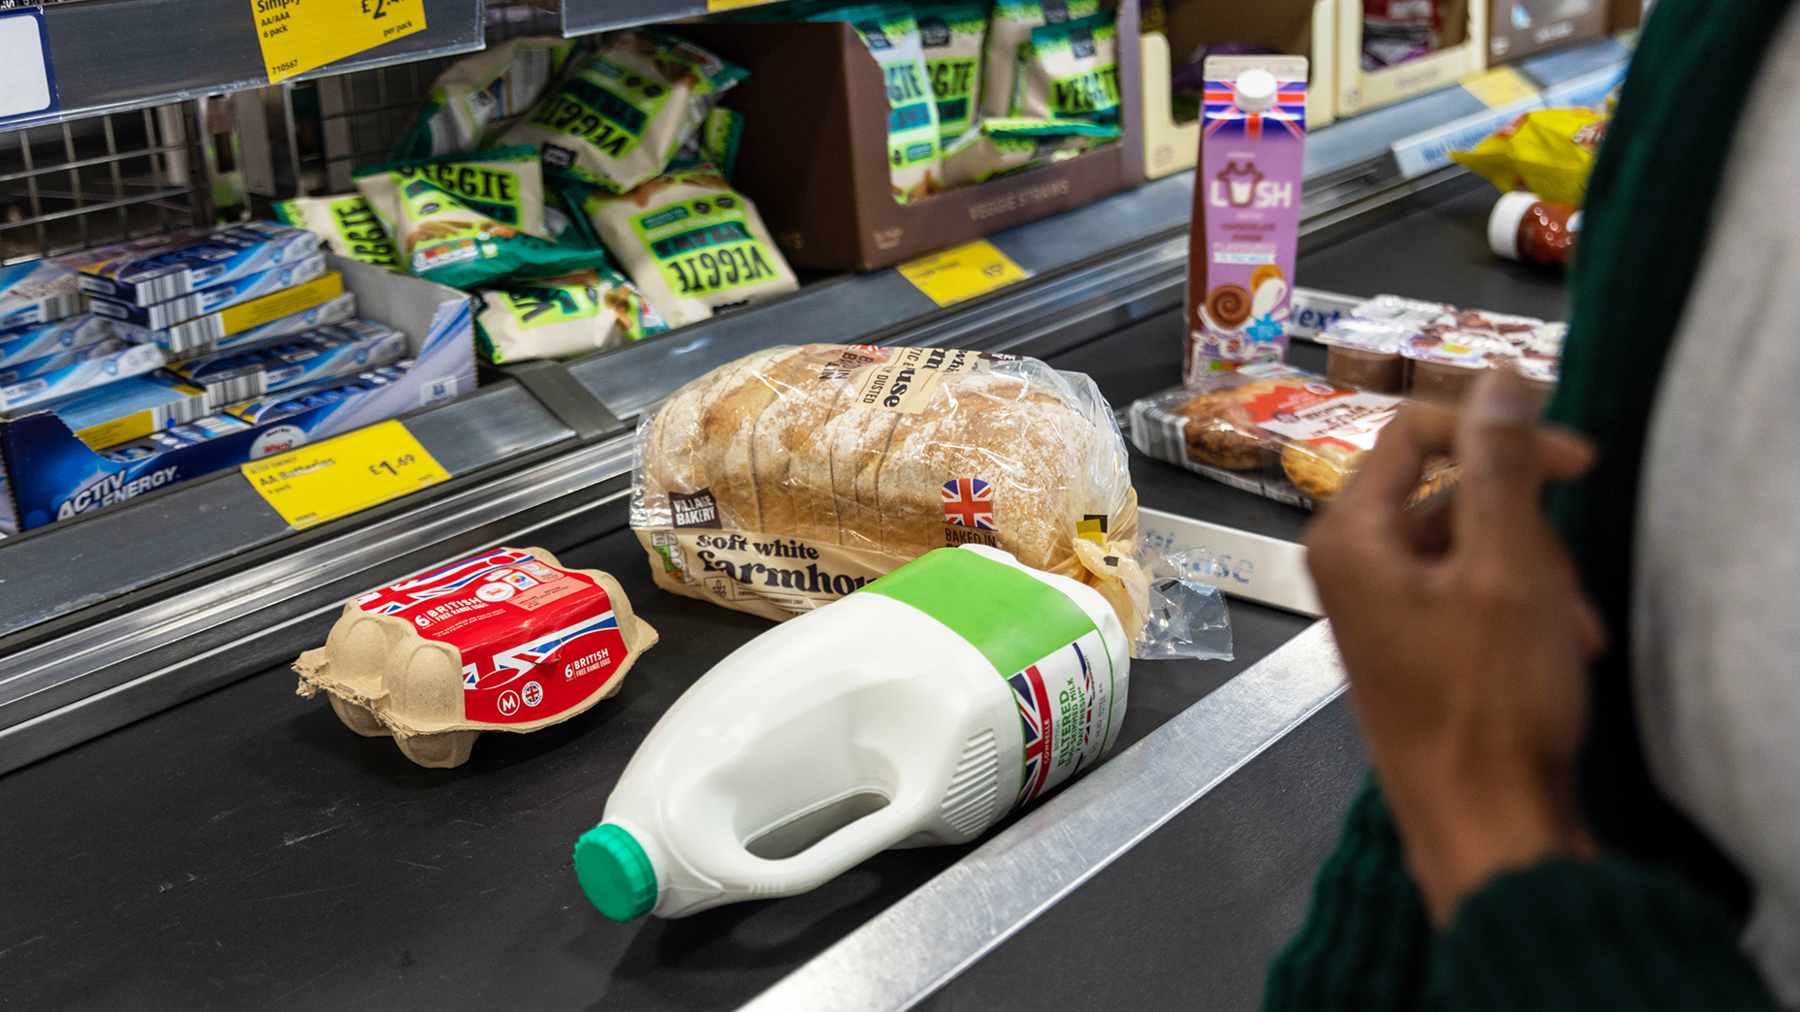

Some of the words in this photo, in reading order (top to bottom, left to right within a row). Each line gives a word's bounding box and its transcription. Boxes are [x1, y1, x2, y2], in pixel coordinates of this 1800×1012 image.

[261, 11, 291, 27] AA/AAA
[383, 27, 396, 38] per
[396, 20, 413, 33] pack
[263, 30, 269, 38] 6
[270, 24, 288, 39] pack
[271, 59, 299, 74] 710567
[666, 246, 774, 293] VEGGIE
[863, 374, 889, 404] DUSTED
[259, 475, 279, 487] AA
[279, 458, 337, 481] Batteries
[369, 453, 416, 477] £1.69
[57, 470, 127, 521] ACTIV
[101, 465, 178, 507] ENERGY
[675, 507, 715, 526] BAKERY
[696, 534, 748, 553] soft
[752, 539, 820, 561] white
[945, 528, 981, 545] BAKED
[415, 615, 430, 627] 6
[426, 597, 482, 617] BRITISH
[435, 613, 452, 624] FREE
[453, 607, 472, 620] RANGE
[472, 602, 489, 612] EGGS
[565, 664, 573, 678] 6
[574, 648, 609, 670] BRITISH
[576, 668, 587, 678] FREE
[587, 664, 600, 674] RANGE
[600, 658, 611, 669] EGGS
[1067, 677, 1077, 702] MILK
[502, 695, 516, 711] M
[1057, 690, 1071, 767] FILTERED
[1064, 703, 1079, 767] SEMI-SKIMMED
[1077, 728, 1086, 746] DAY
